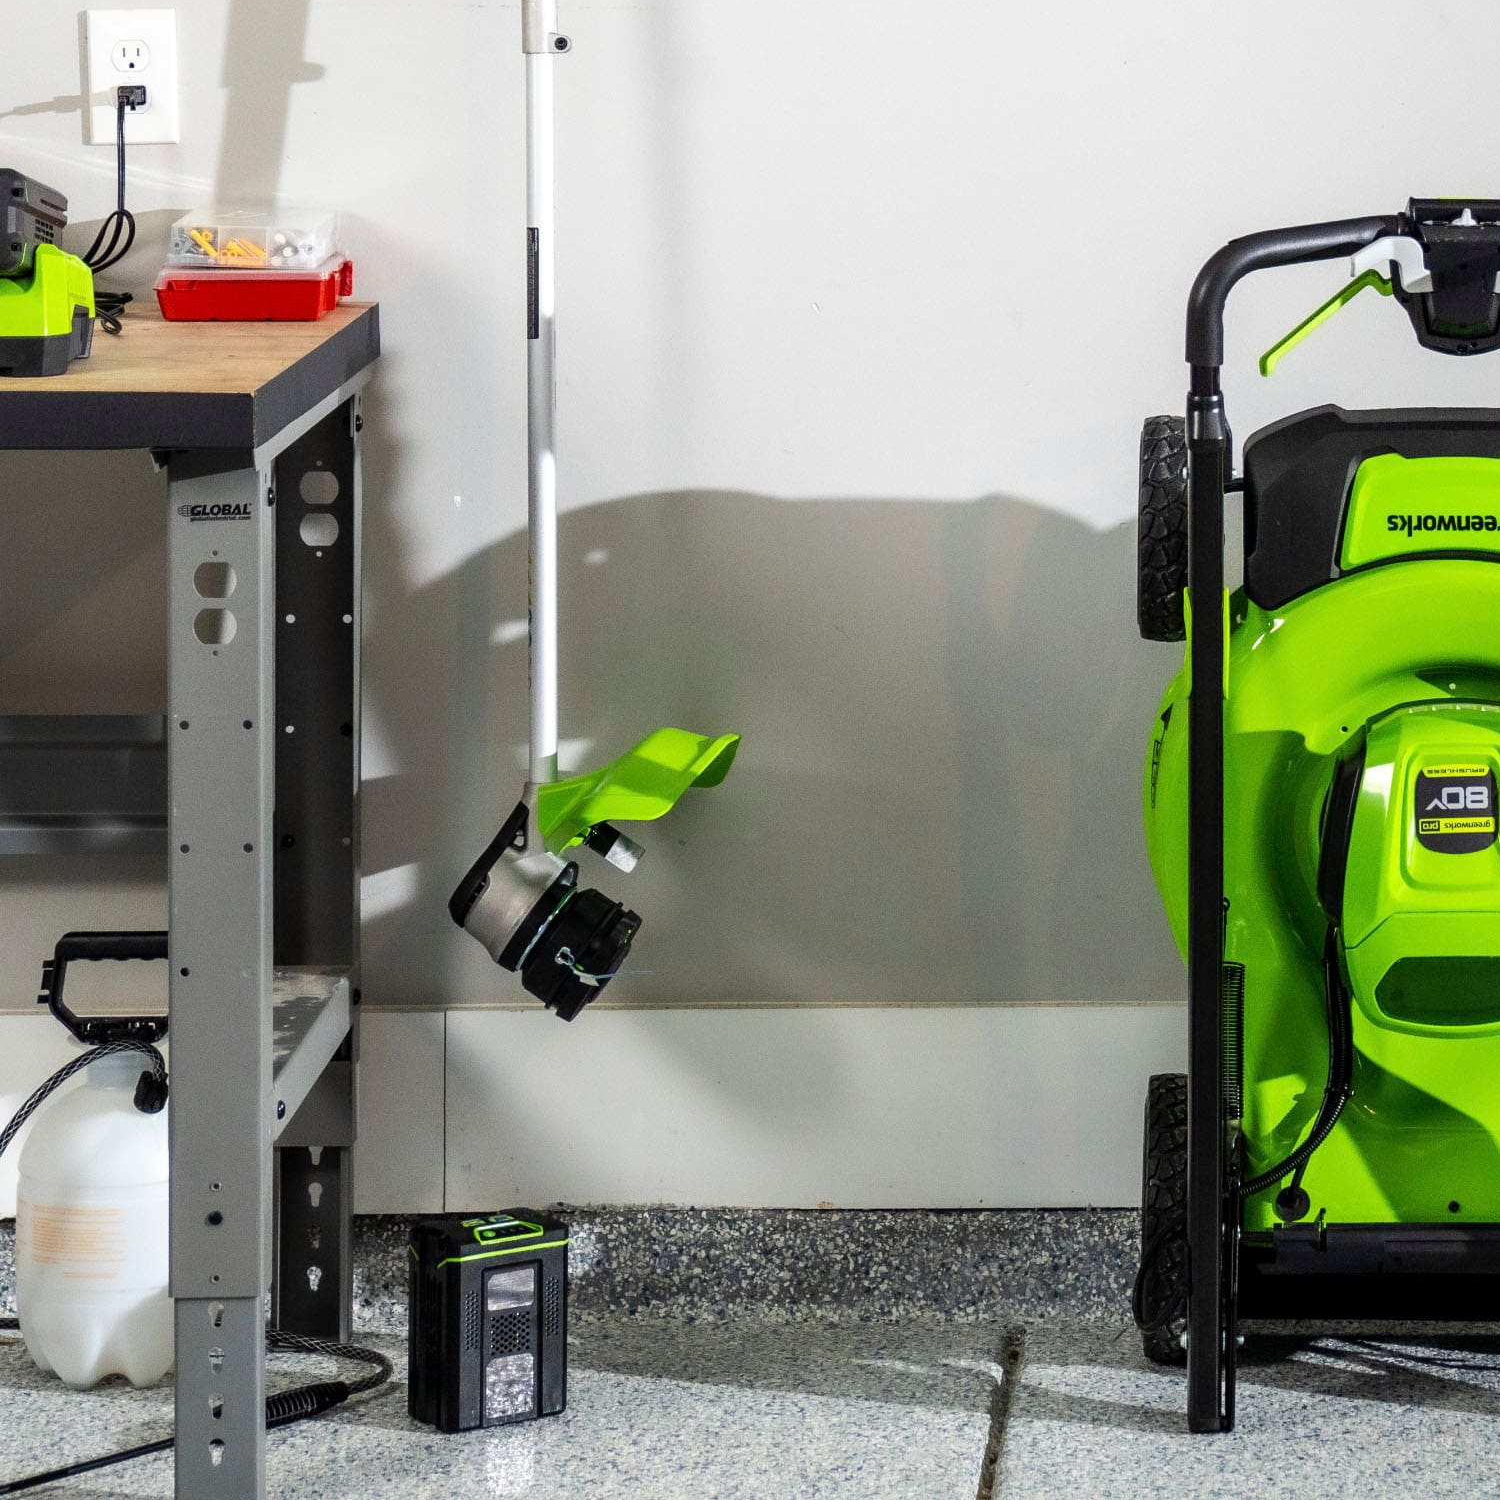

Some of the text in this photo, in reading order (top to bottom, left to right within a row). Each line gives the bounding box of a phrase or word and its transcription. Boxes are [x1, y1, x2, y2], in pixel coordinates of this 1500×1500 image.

[190, 503, 251, 517] GLOBAL
[1422, 820, 1490, 830] greenworks pro
